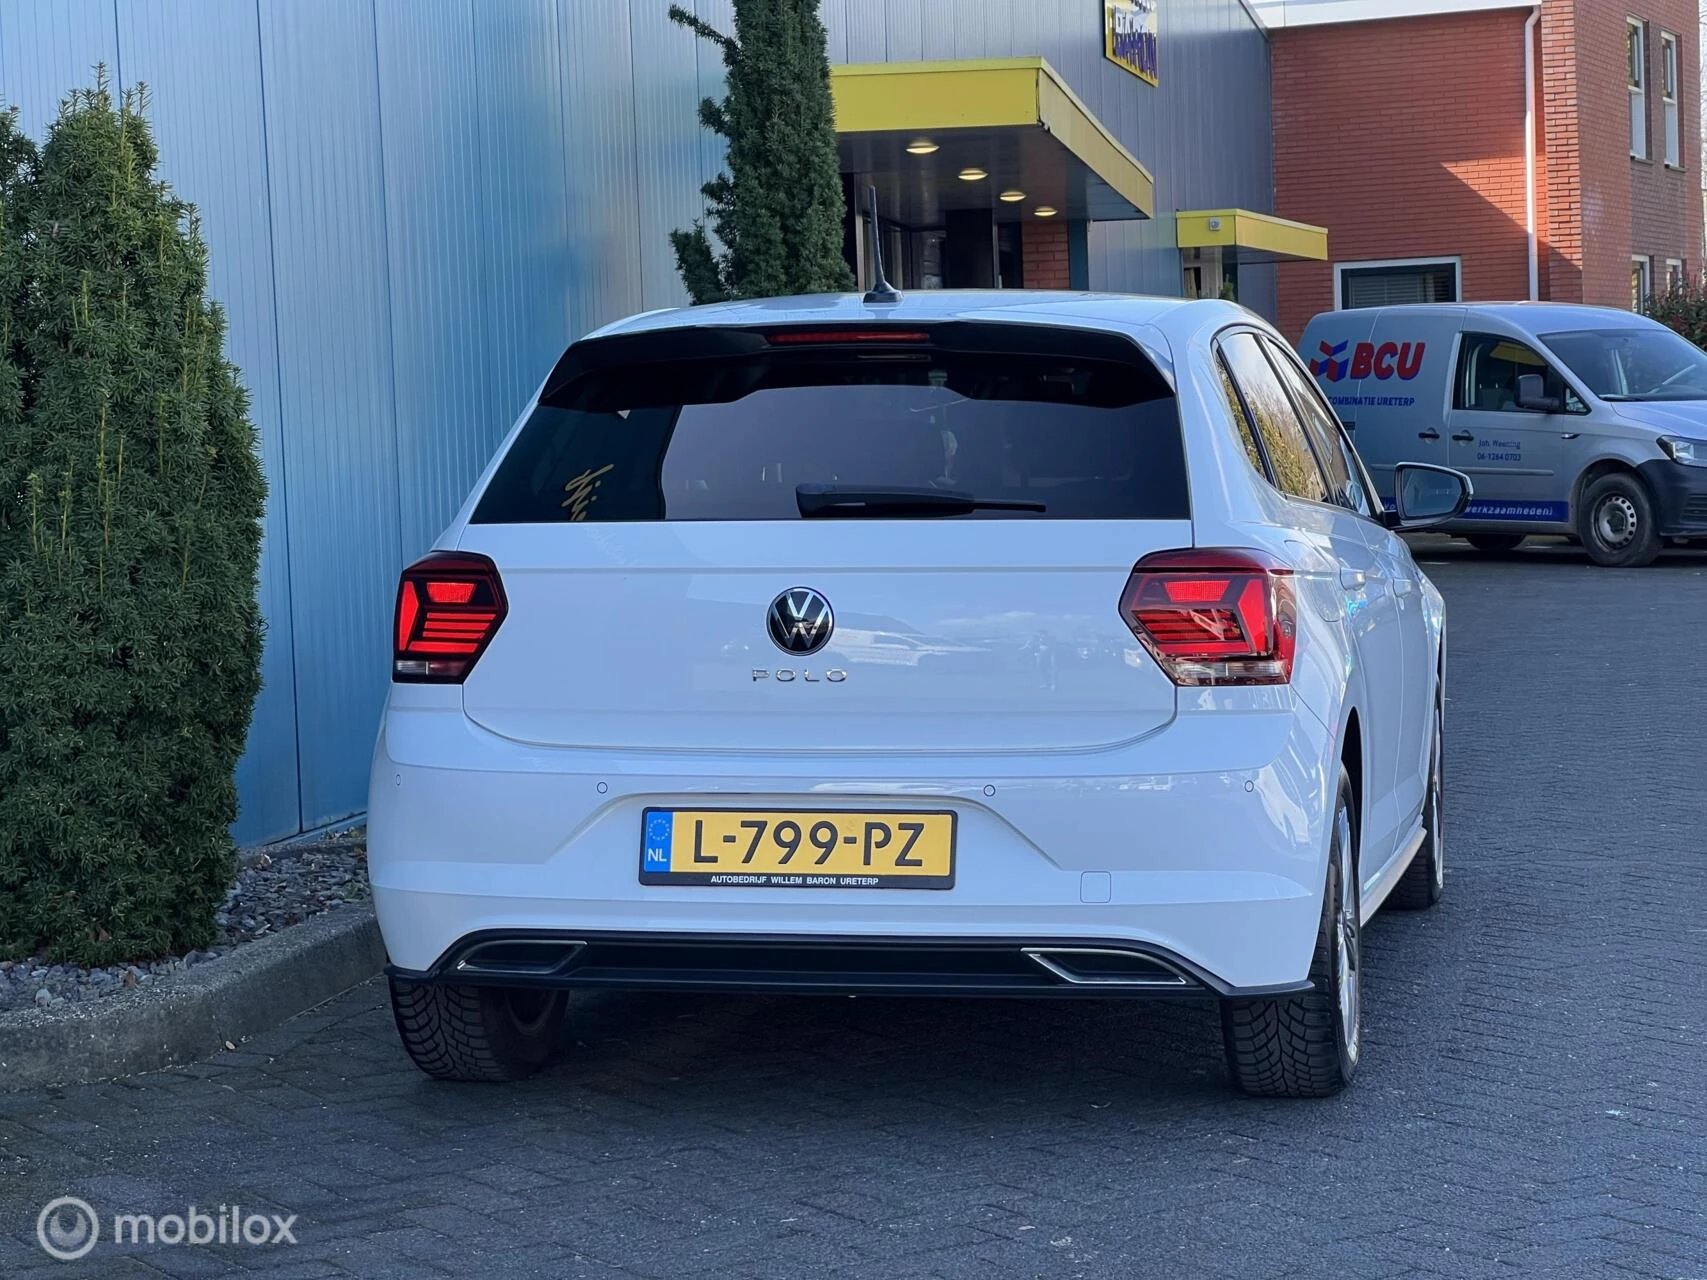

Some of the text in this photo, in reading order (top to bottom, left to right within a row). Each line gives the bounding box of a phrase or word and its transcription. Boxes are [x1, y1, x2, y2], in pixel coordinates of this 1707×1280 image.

[1350, 341, 1426, 381] BCU
[1376, 396, 1415, 407] URETERP
[767, 587, 834, 656] VW
[752, 668, 848, 682] POLO
[694, 819, 924, 867] L-799-PZ
[647, 847, 667, 863] NL
[710, 875, 879, 886] AUTOBEDRIJF WILLEM BARON URETERP
